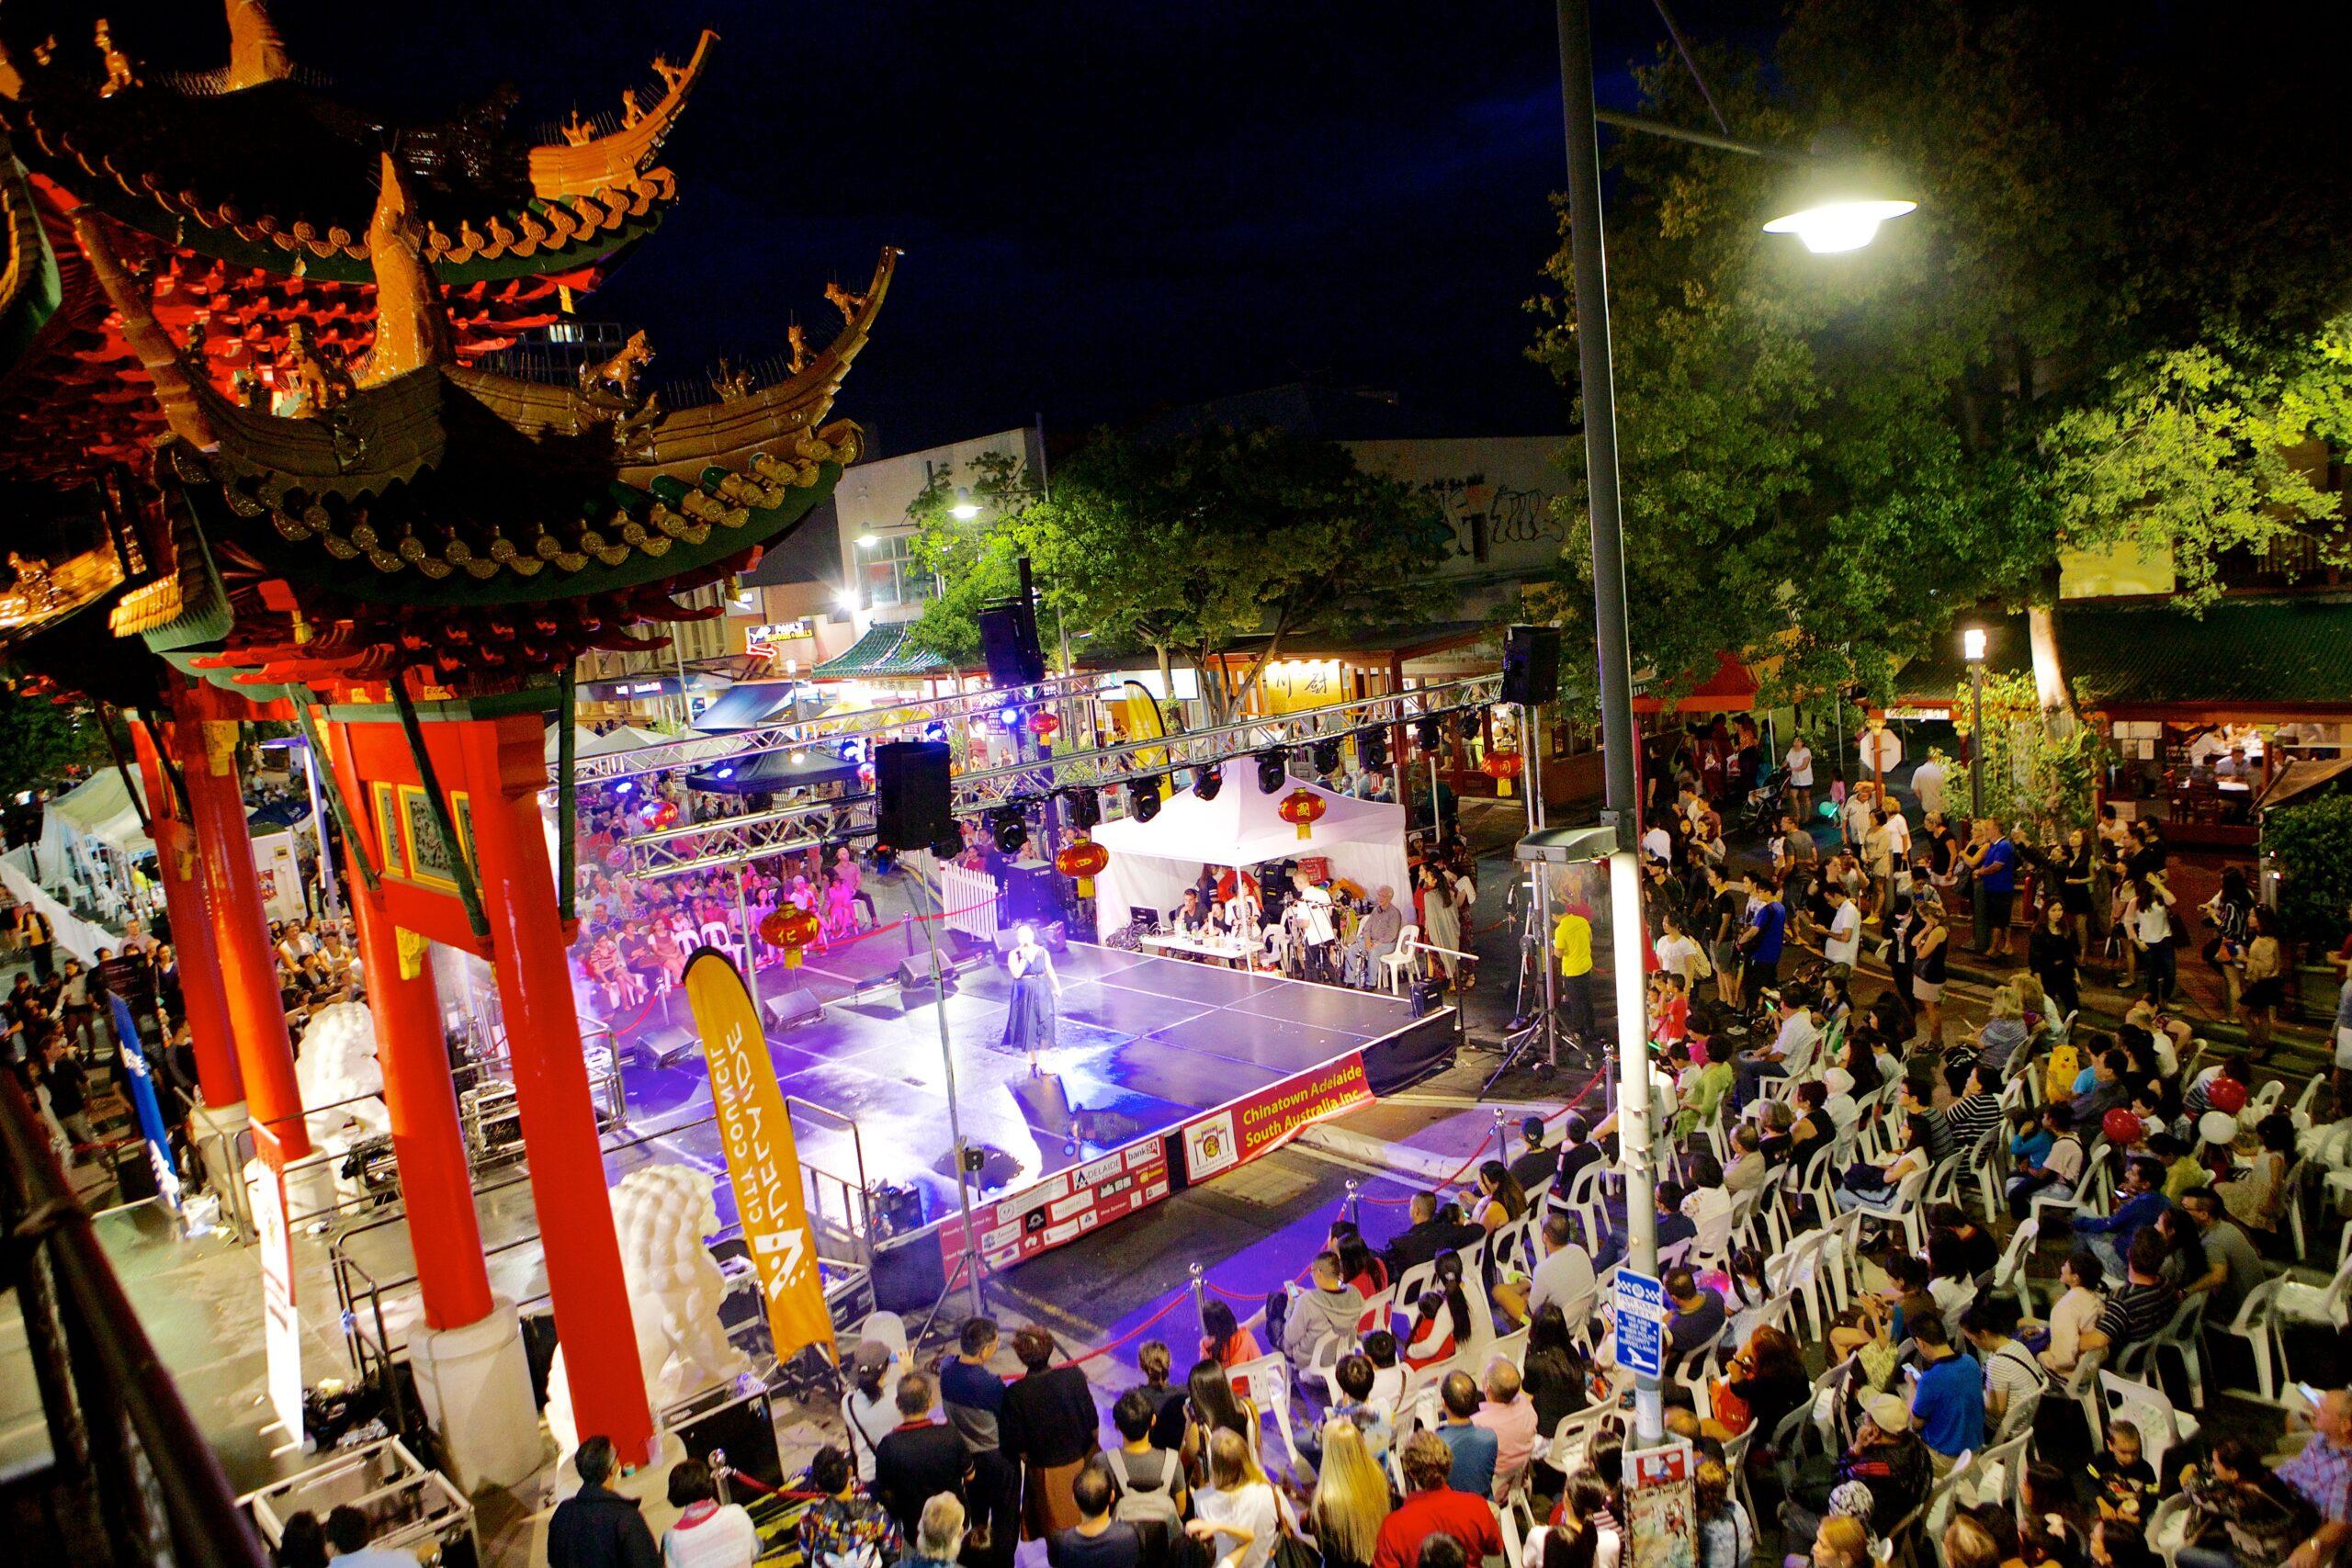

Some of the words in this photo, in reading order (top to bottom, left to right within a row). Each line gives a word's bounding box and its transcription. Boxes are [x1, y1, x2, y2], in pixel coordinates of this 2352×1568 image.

[1243, 1089, 1309, 1125] Chinatown
[1311, 1065, 1363, 1095] Adelaide
[1245, 1121, 1283, 1148] South
[1283, 1096, 1340, 1130] Australia
[1340, 1087, 1365, 1106] Inc.
[1127, 1141, 1158, 1160] bankSA
[1619, 1294, 1635, 1305] FOR
[1637, 1300, 1657, 1313] YOUR
